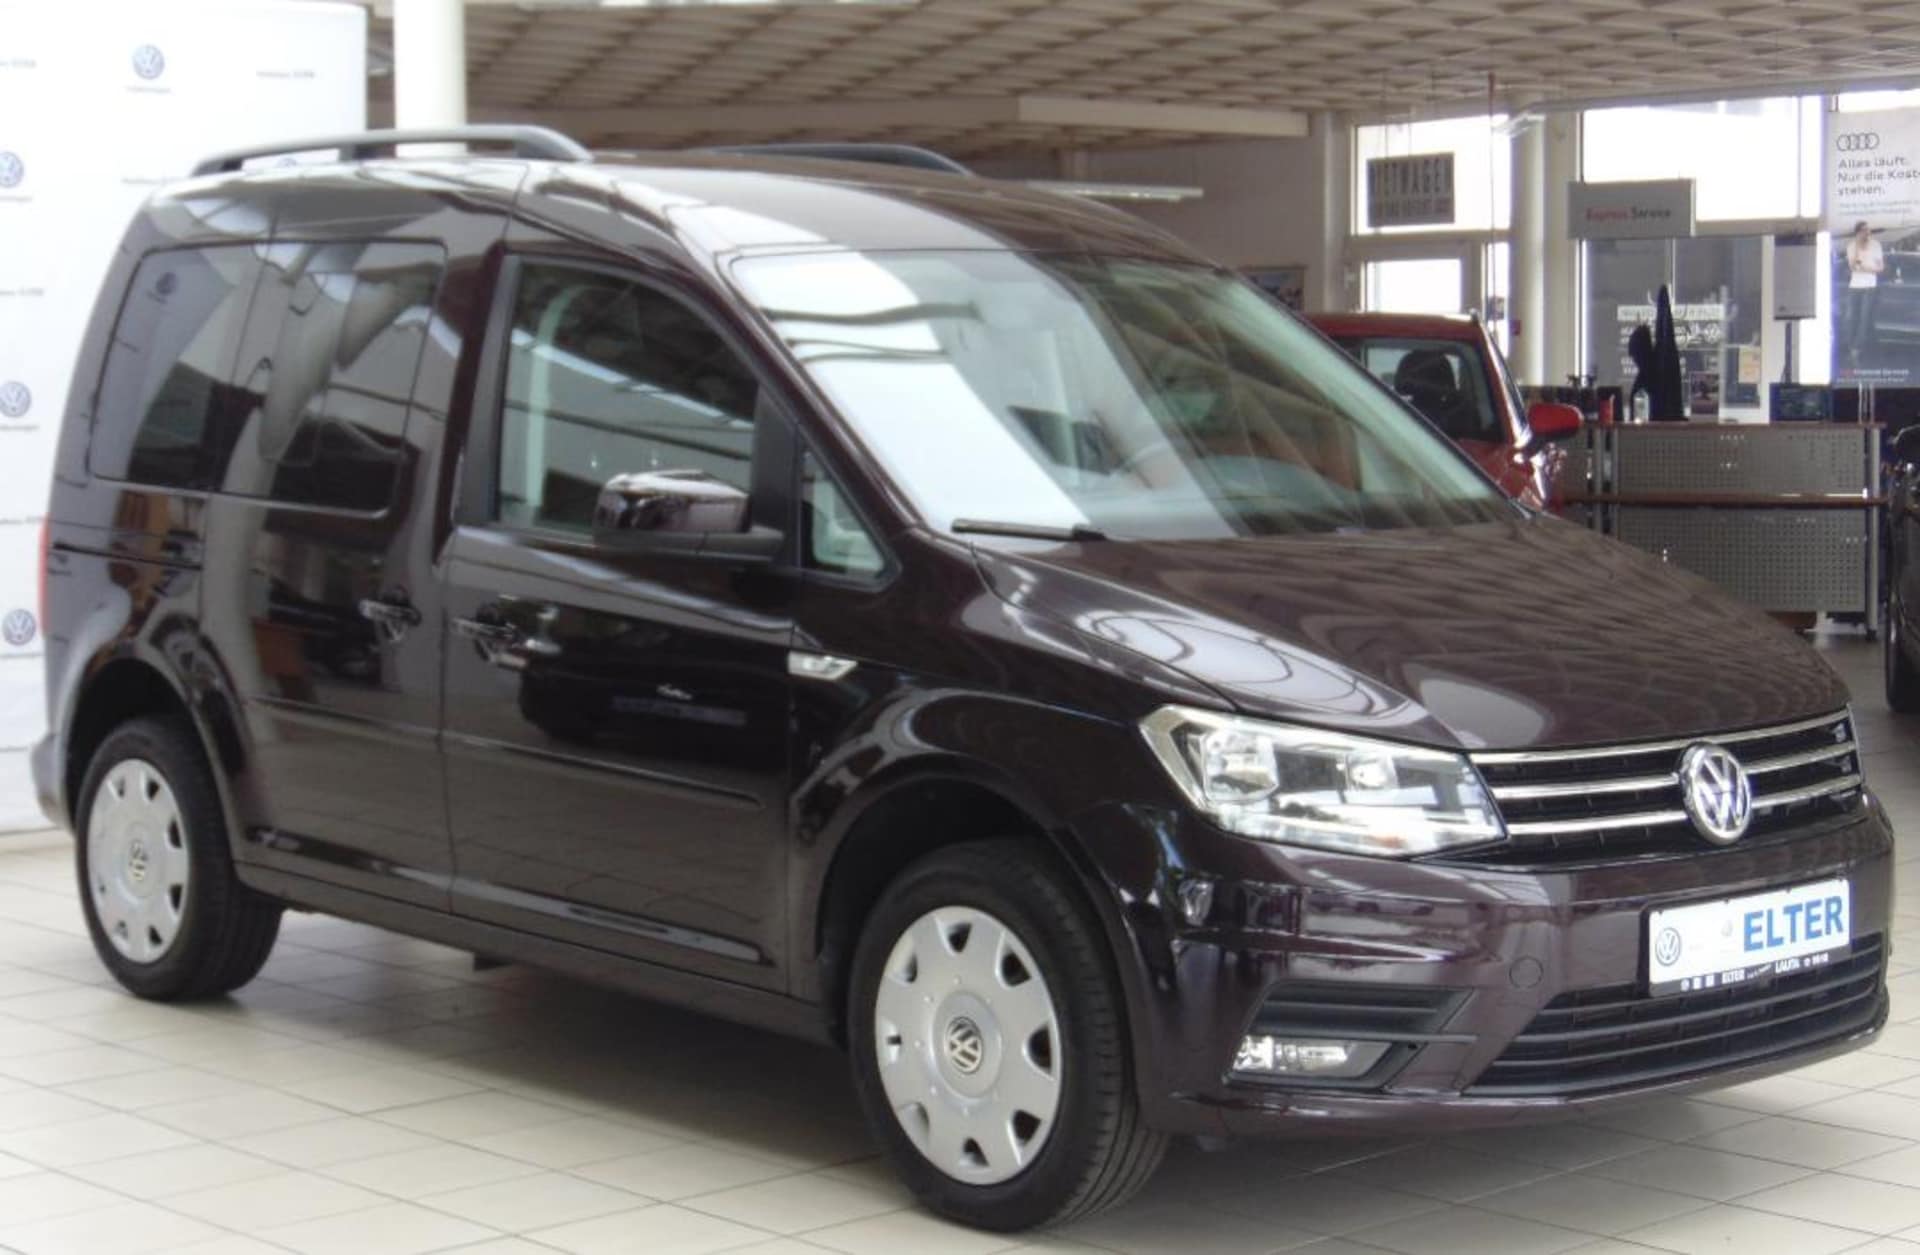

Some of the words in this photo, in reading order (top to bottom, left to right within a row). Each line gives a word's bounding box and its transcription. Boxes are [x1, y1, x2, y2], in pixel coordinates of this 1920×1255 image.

[1839, 159, 1871, 169] Alles
[1838, 172, 1860, 183] Nur
[1864, 170, 1884, 181] die
[1887, 168, 1920, 180] Kost
[1743, 895, 1844, 953] ELTER
